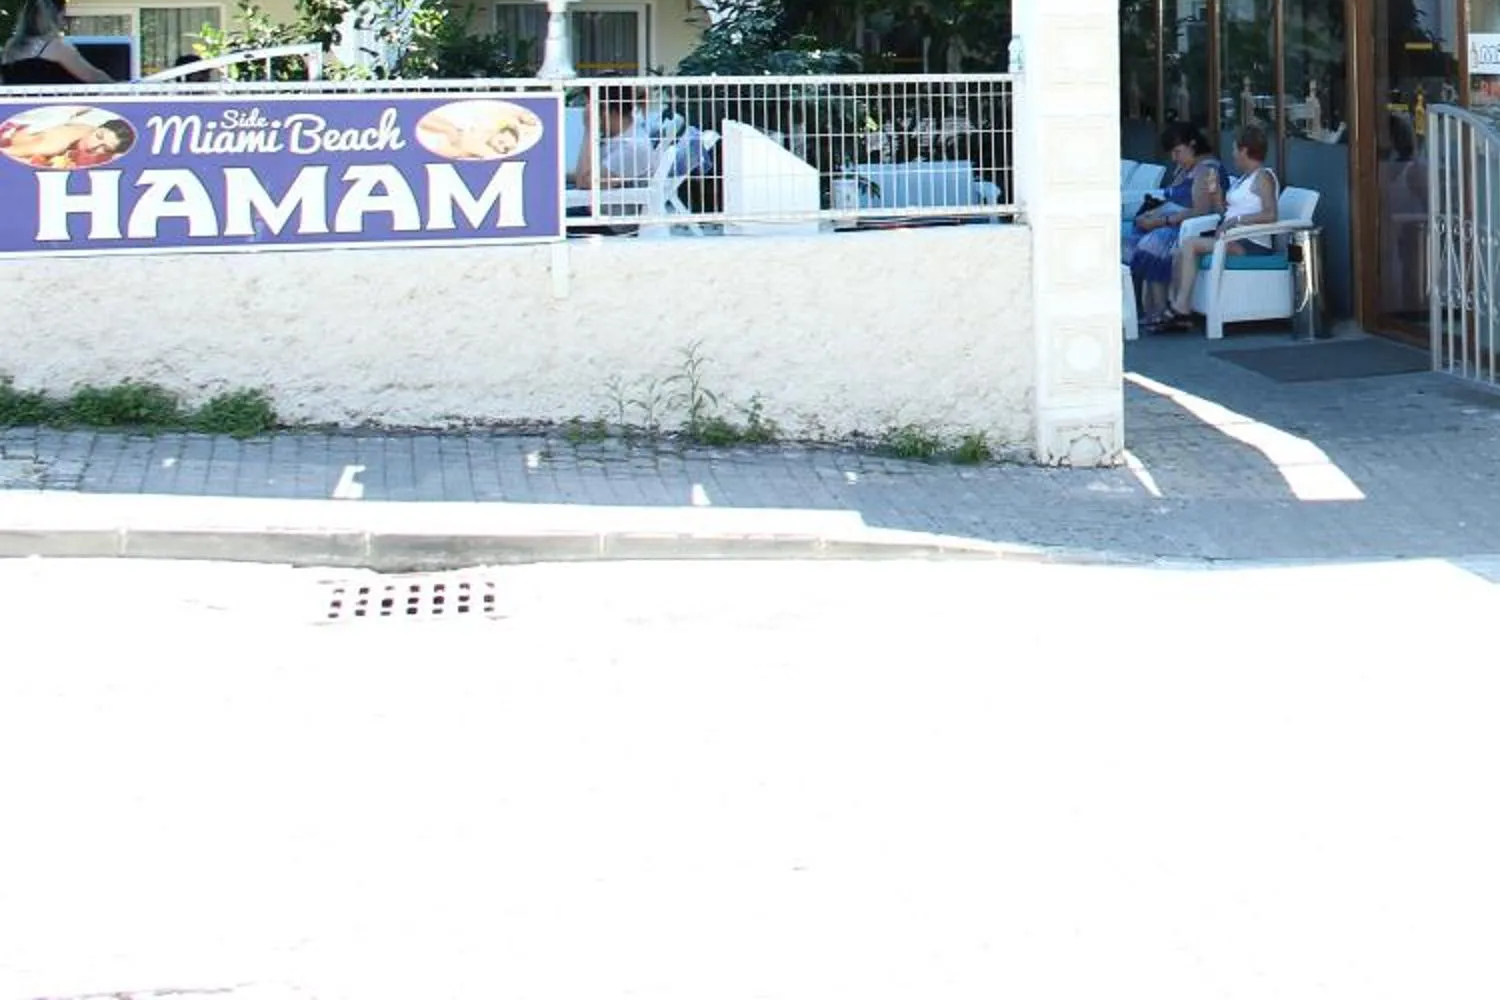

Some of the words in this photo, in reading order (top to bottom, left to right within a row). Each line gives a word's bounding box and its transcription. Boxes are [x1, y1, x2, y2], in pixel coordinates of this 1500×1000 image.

[147, 115, 285, 155] Miami
[284, 107, 406, 154] Beach
[220, 108, 268, 129] Side
[35, 160, 528, 241] HAMAM
